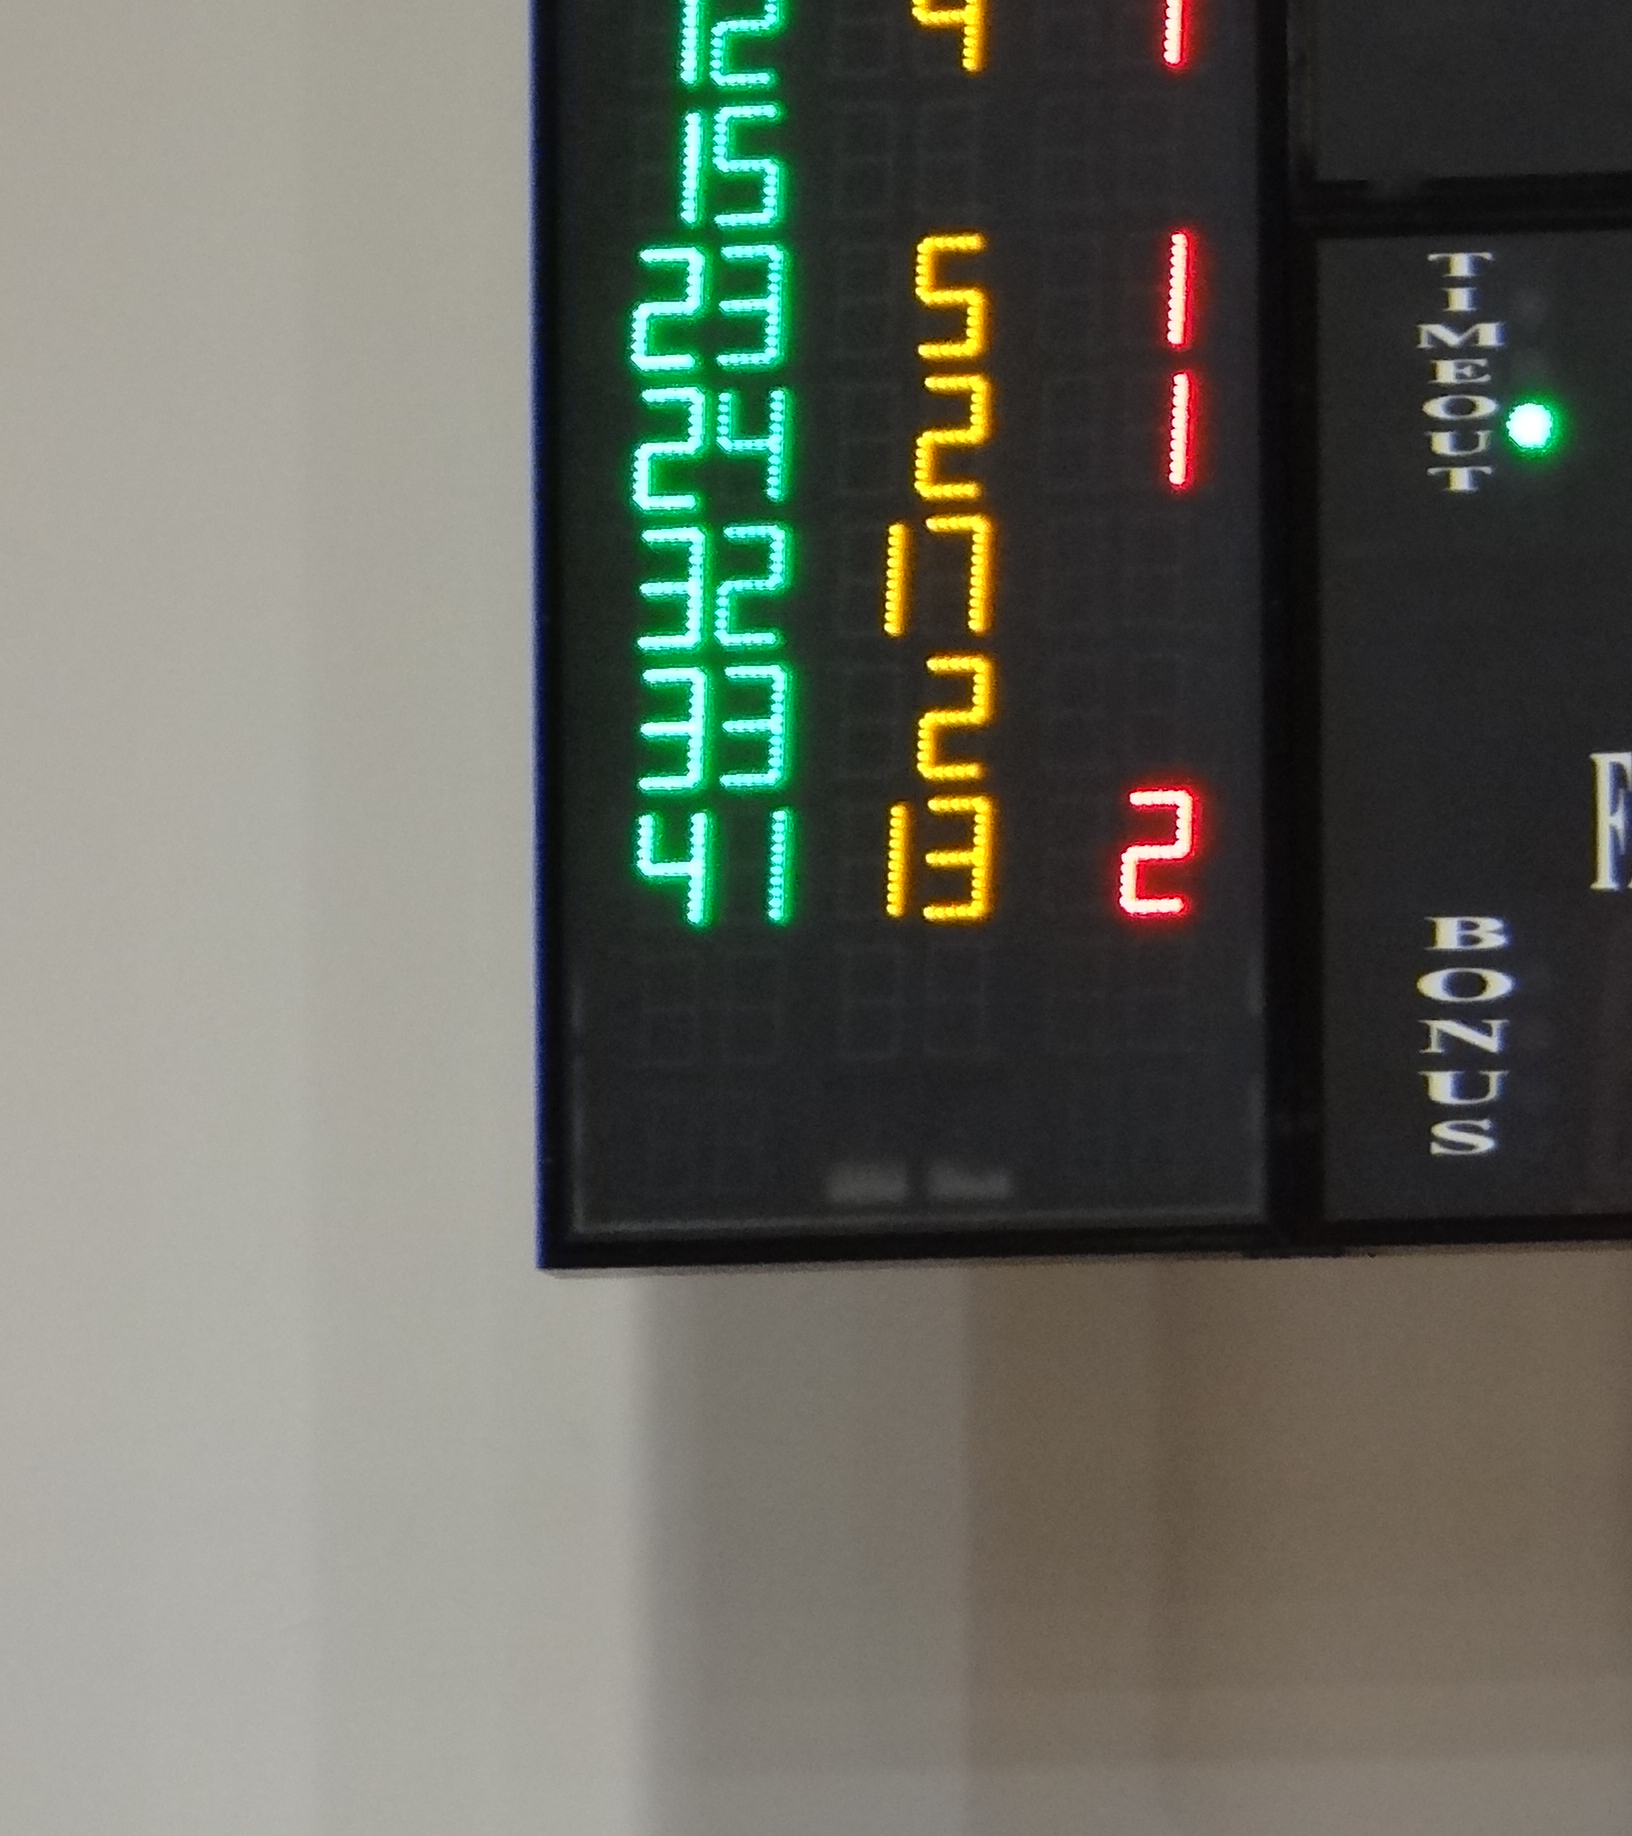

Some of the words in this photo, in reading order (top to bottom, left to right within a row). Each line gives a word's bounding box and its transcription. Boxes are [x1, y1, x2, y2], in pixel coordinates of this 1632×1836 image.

[679, 103, 786, 228] 15
[629, 243, 790, 374] 23
[914, 232, 988, 360] 5
[1165, 228, 1198, 352] 1
[1415, 250, 1508, 494] TIMEOUT
[630, 385, 792, 516] 24
[912, 373, 992, 501] 2
[1167, 368, 1200, 491] 1
[635, 523, 793, 653] 32
[882, 513, 993, 638] 17
[637, 663, 793, 793] 33
[915, 653, 993, 782] 2
[635, 808, 794, 926] 41
[885, 794, 995, 922] 13
[1117, 784, 1204, 921] 2
[1415, 914, 1516, 1158] BONUS
